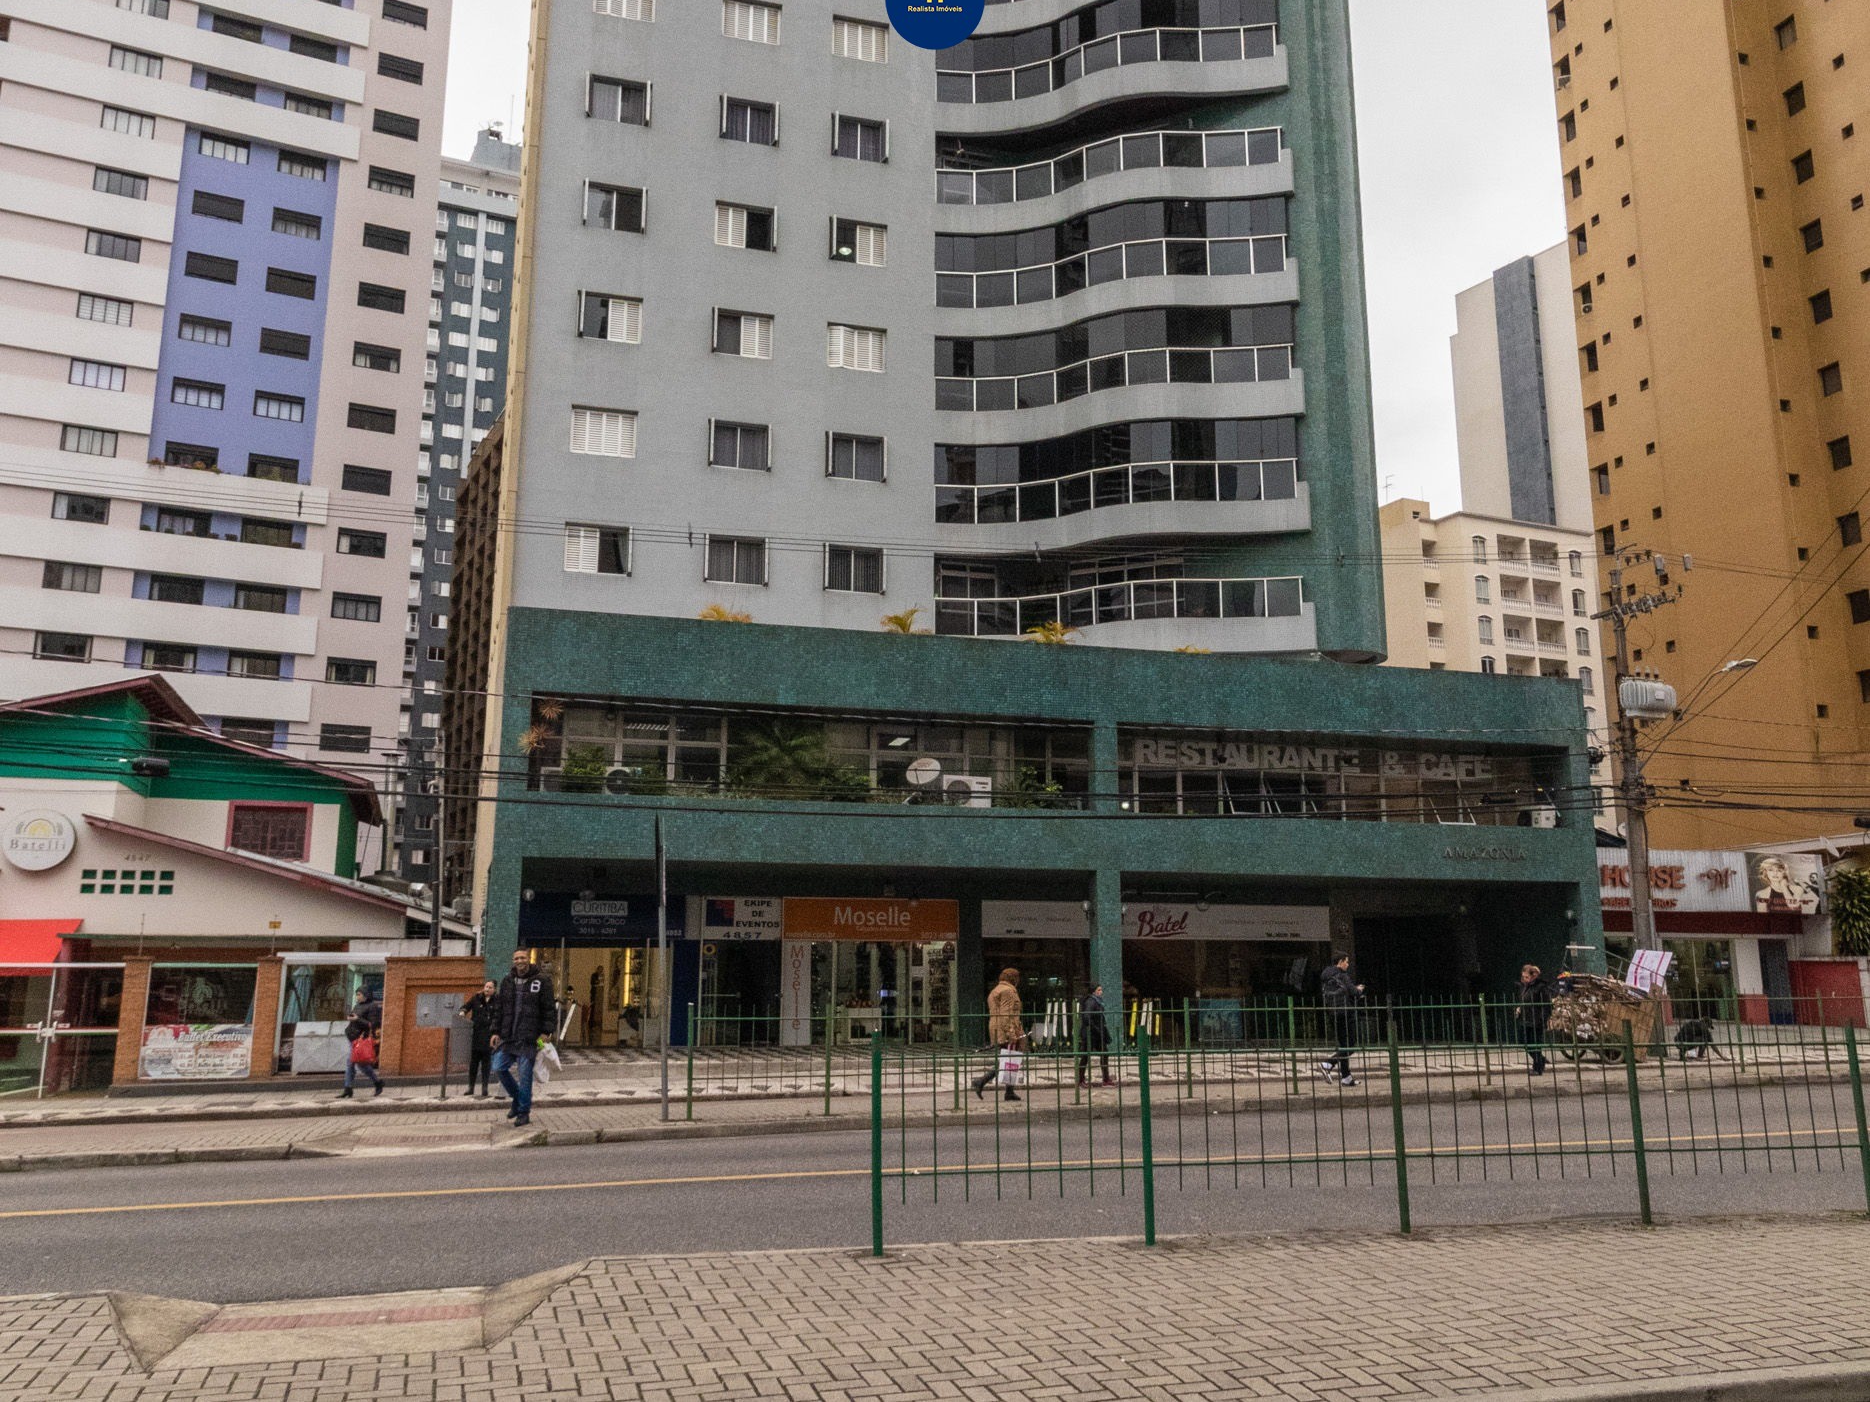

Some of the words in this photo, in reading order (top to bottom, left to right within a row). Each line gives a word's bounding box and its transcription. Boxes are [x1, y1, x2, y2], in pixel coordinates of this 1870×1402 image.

[1134, 739, 1361, 774] RESTAURANTE
[1383, 751, 1405, 775] &
[10, 838, 66, 850] Batelli
[572, 901, 627, 914] CURITIBA
[751, 910, 764, 918] DE
[834, 905, 912, 926] Moselle
[735, 920, 780, 928] EVENTOS
[1137, 909, 1189, 937] Batel
[530, 979, 541, 993] B
[790, 945, 804, 1030] Moselle
